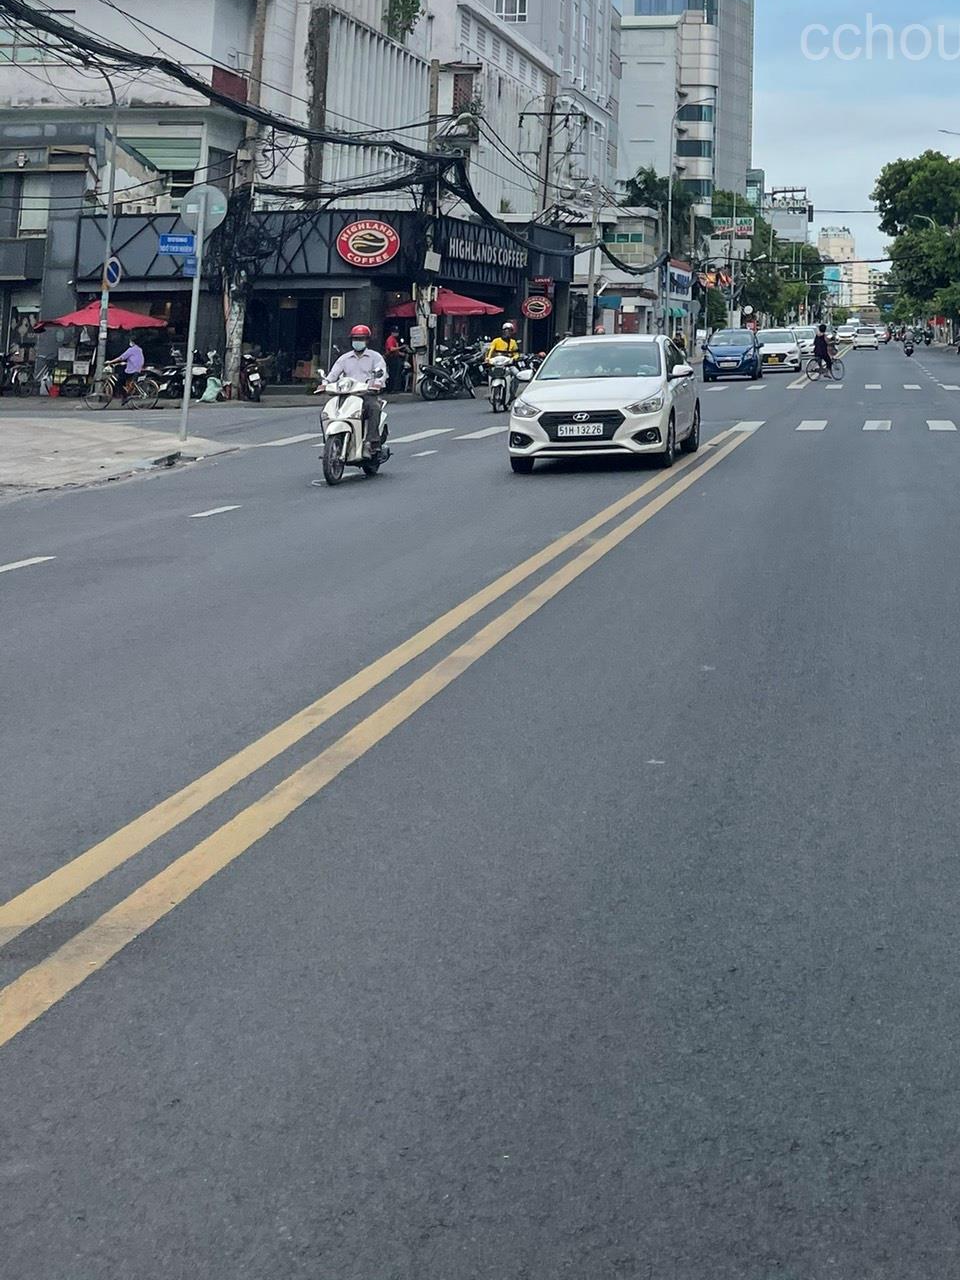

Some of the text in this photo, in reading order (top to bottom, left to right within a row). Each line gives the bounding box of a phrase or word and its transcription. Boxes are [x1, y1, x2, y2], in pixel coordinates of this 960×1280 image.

[340, 222, 397, 242] HIGHLANDS
[346, 252, 390, 264] COFFEE
[448, 237, 497, 265] HIGHLANDS
[498, 247, 524, 269] COFFEE
